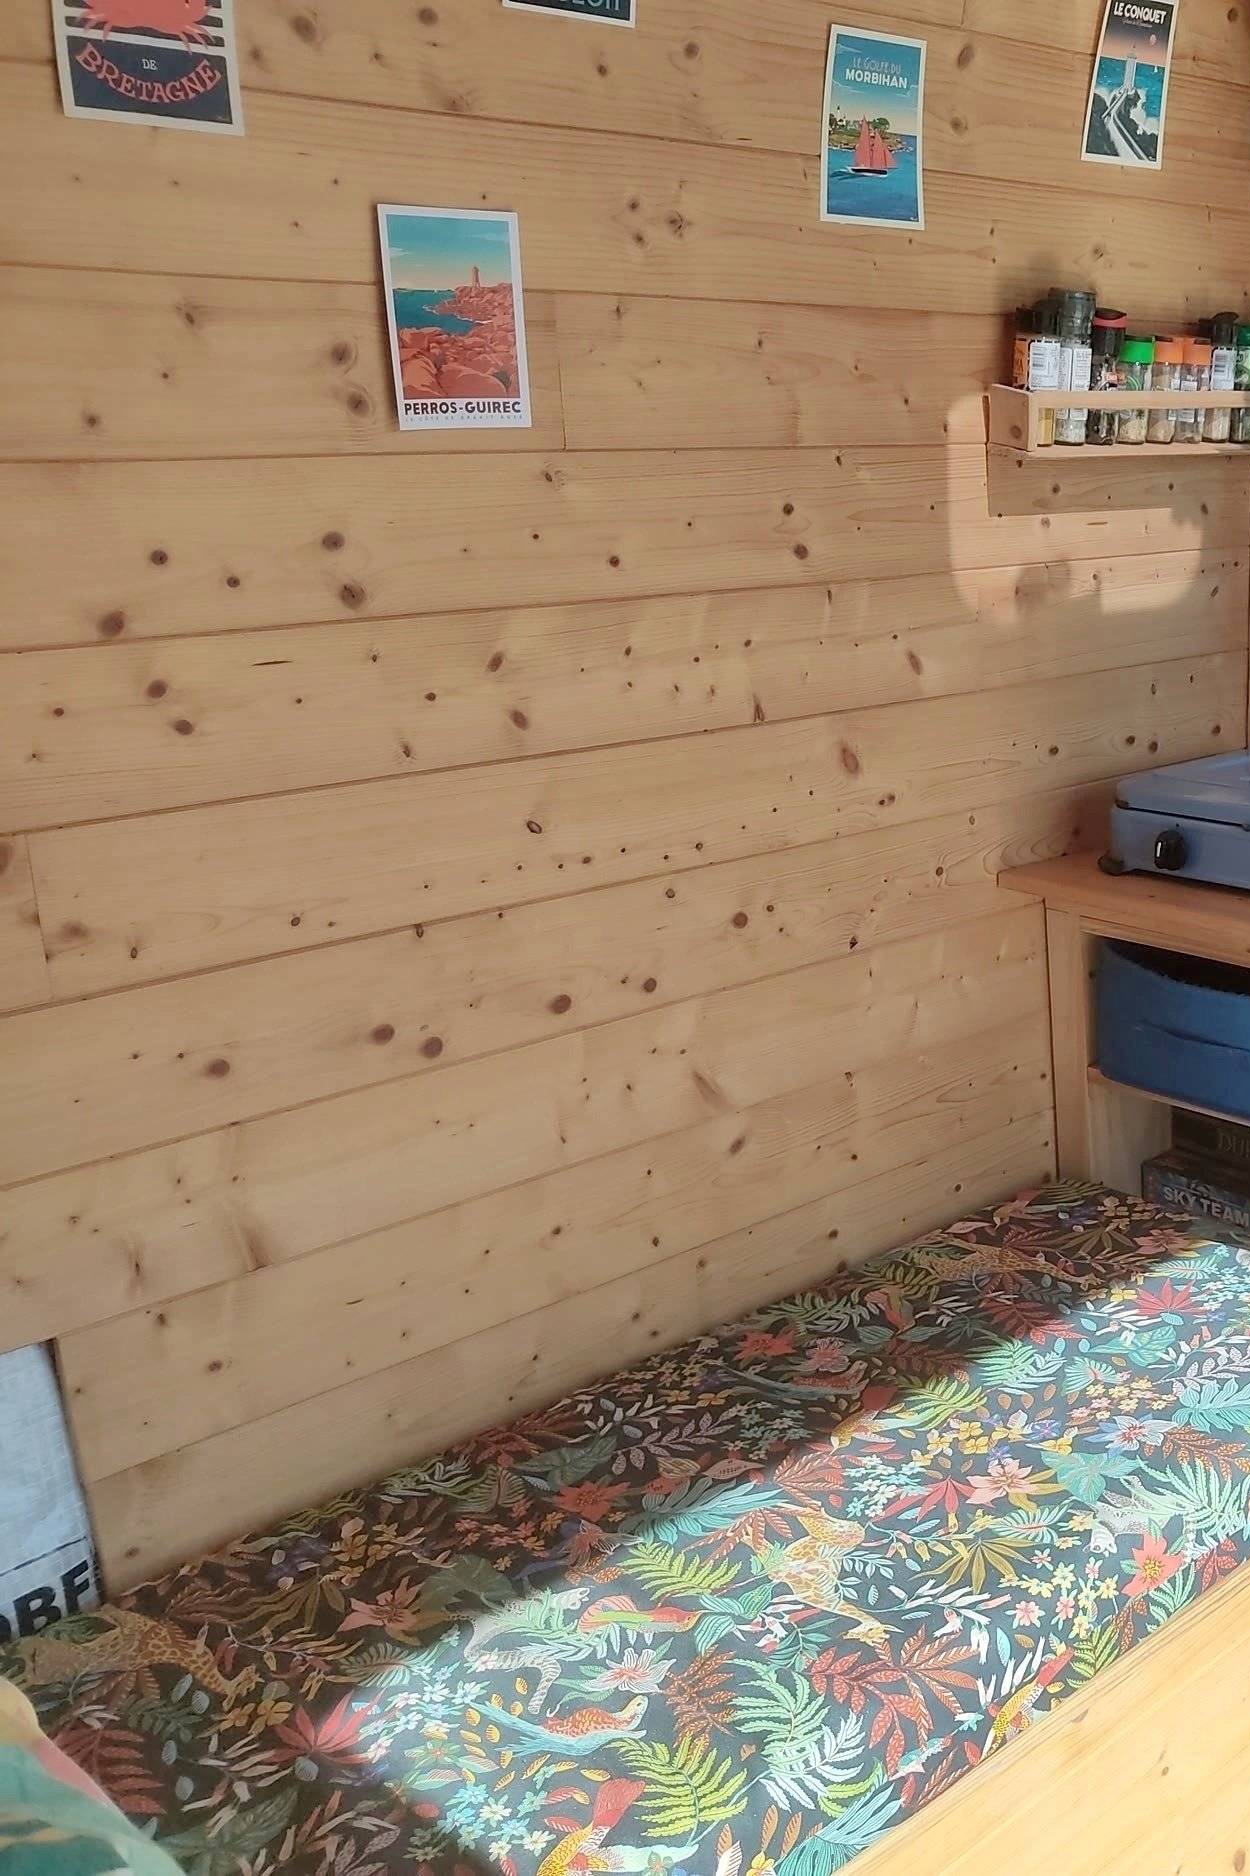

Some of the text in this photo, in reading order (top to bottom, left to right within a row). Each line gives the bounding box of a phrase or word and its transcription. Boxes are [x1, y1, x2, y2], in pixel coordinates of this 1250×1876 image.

[1113, 2, 1125, 16] LE
[1124, 4, 1167, 24] CONQUET
[75, 42, 222, 103] BRETAGNE
[142, 58, 158, 71] DE
[890, 63, 902, 75] DU
[845, 68, 908, 89] MORBIHAN
[404, 401, 522, 415] PERROS-GUIREC
[1163, 1186, 1249, 1227] SKY TEAM
